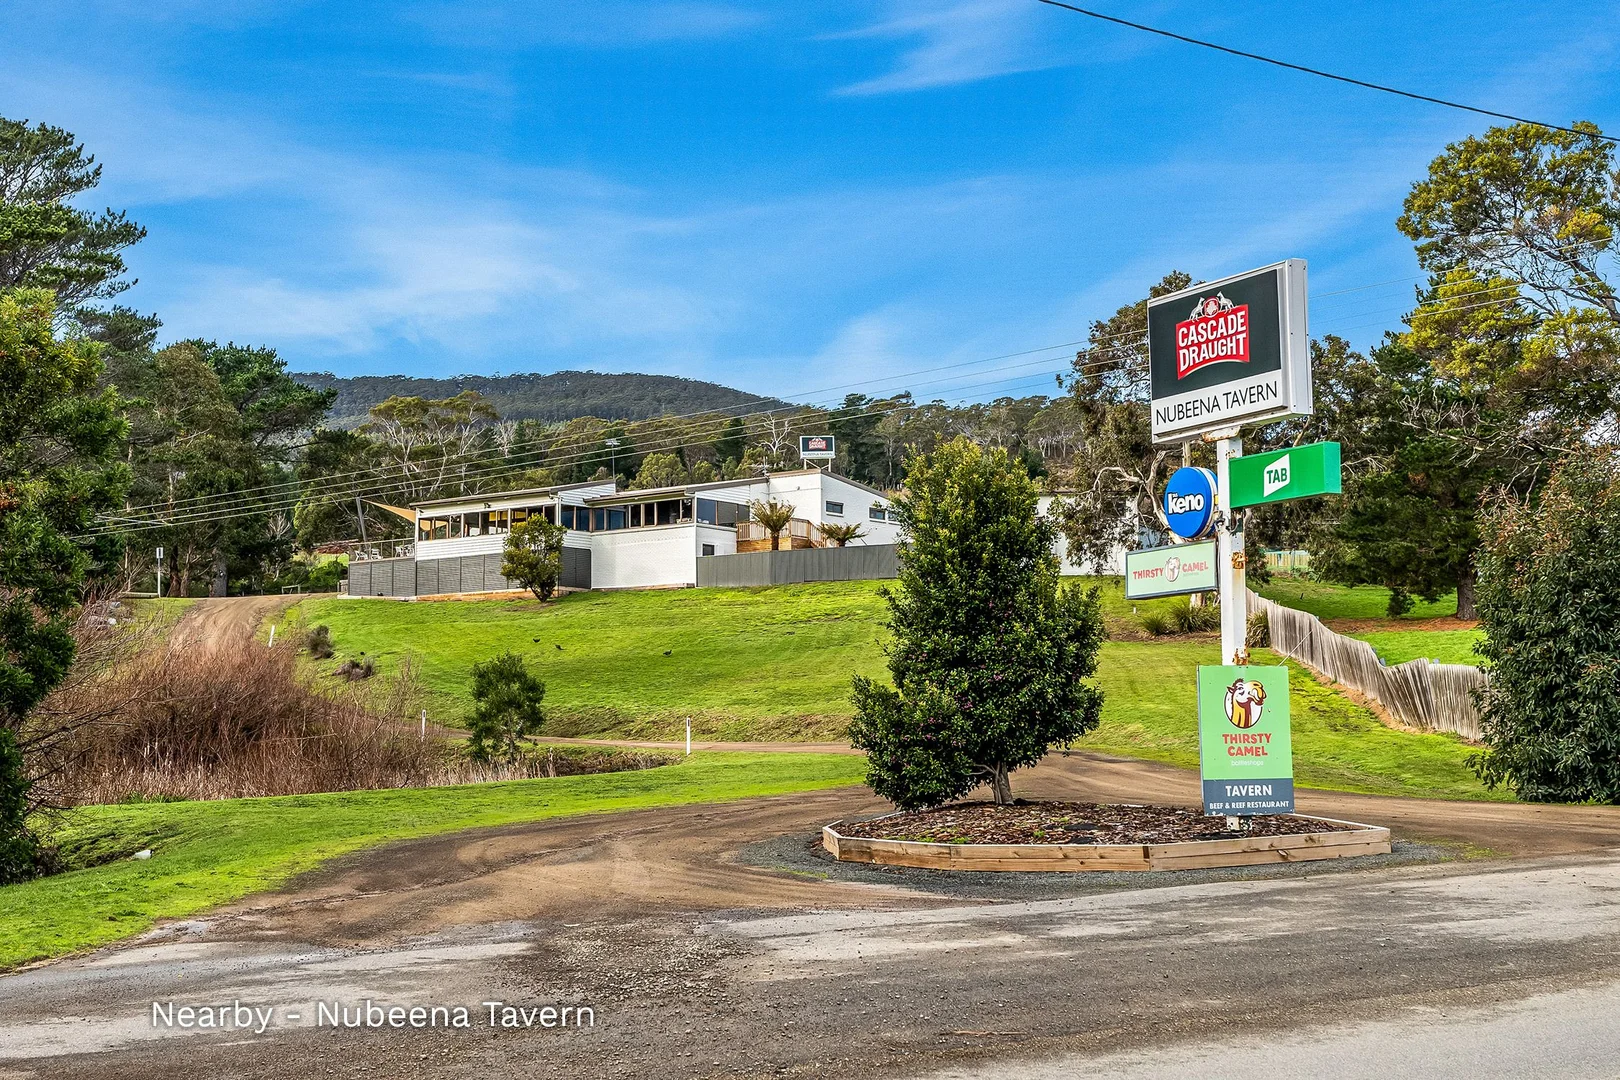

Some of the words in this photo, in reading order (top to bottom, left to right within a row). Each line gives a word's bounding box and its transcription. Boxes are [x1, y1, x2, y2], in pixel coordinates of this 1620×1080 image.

[1178, 310, 1247, 347] CASCADE
[1179, 332, 1247, 372] DRAUGHT
[1156, 395, 1221, 425] NUBEENA
[1223, 380, 1278, 409] TAVERN
[1266, 467, 1288, 484] TAB
[1132, 567, 1164, 580] THIRSTY
[1182, 561, 1208, 572] CAMEL
[1222, 733, 1272, 744] THIRSTY
[1227, 745, 1268, 757] CAMEL
[1225, 784, 1272, 797] TAVERN
[1231, 801, 1245, 809] REEF
